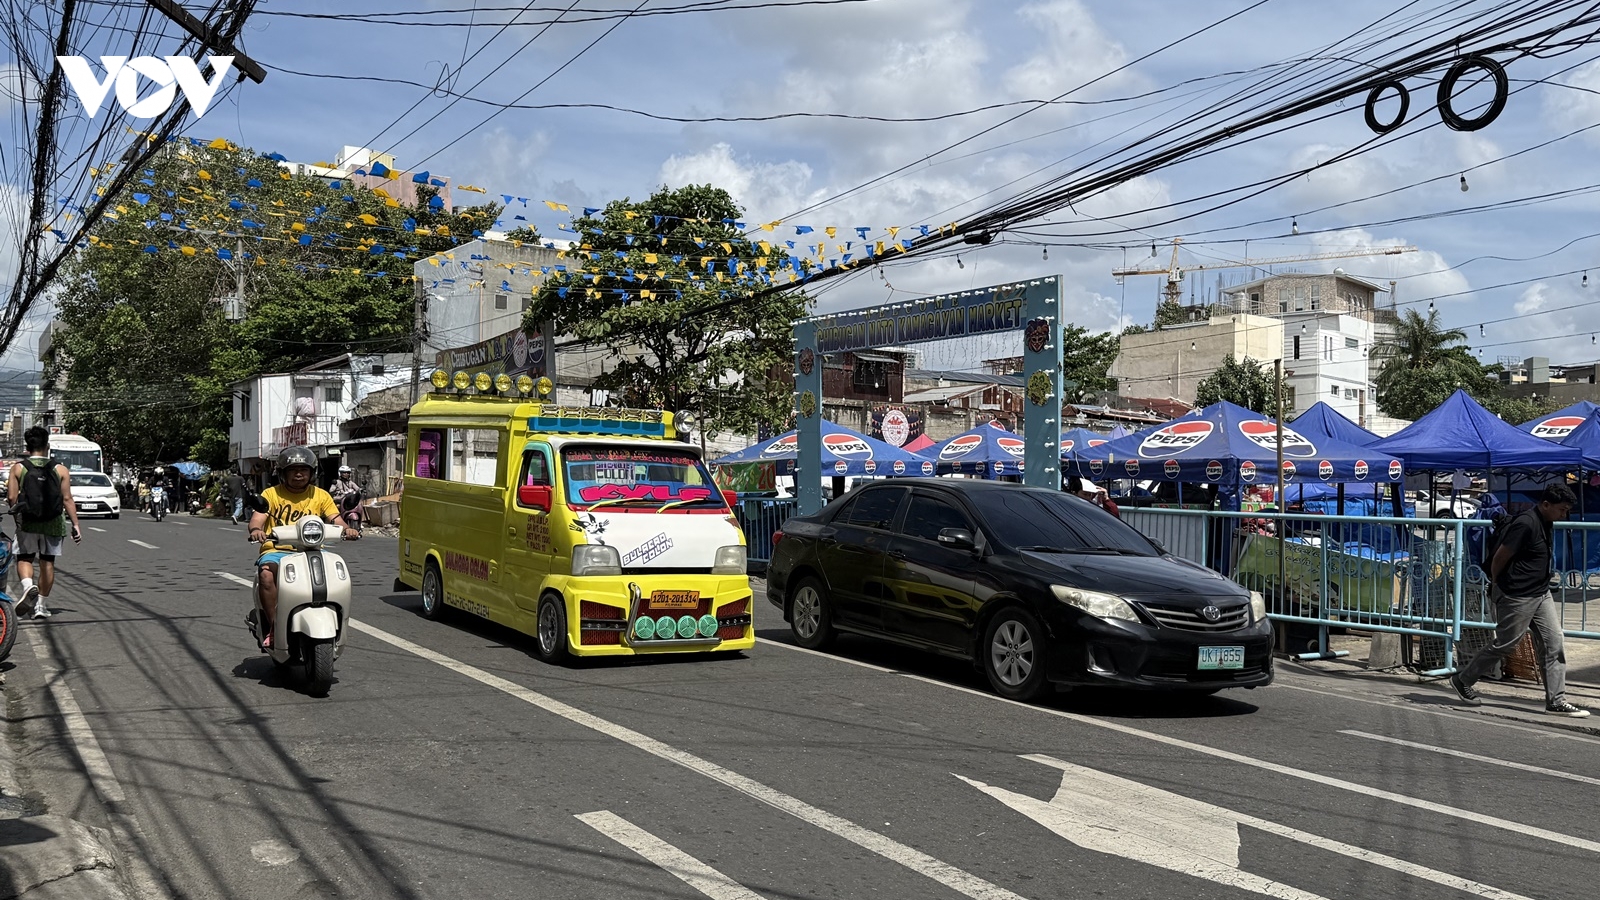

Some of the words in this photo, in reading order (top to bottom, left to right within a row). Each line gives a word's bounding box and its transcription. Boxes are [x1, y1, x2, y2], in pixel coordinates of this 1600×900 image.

[816, 322, 866, 353] CHIBUGAN
[868, 318, 895, 347] NATO
[898, 306, 965, 342] KAMAGAYAN
[968, 298, 1023, 333] MARKET
[529, 339, 544, 349] PEPSI
[450, 347, 486, 368] CHIBUGAN
[1534, 427, 1572, 435] PEP
[1148, 433, 1207, 444] PEPSI
[827, 443, 868, 452] PEPSI
[945, 444, 977, 452] PEPSI
[579, 483, 711, 501] KYLE
[642, 537, 674, 564] COLON
[652, 594, 697, 603] 1201-201314
[1223, 648, 1241, 662] 855
